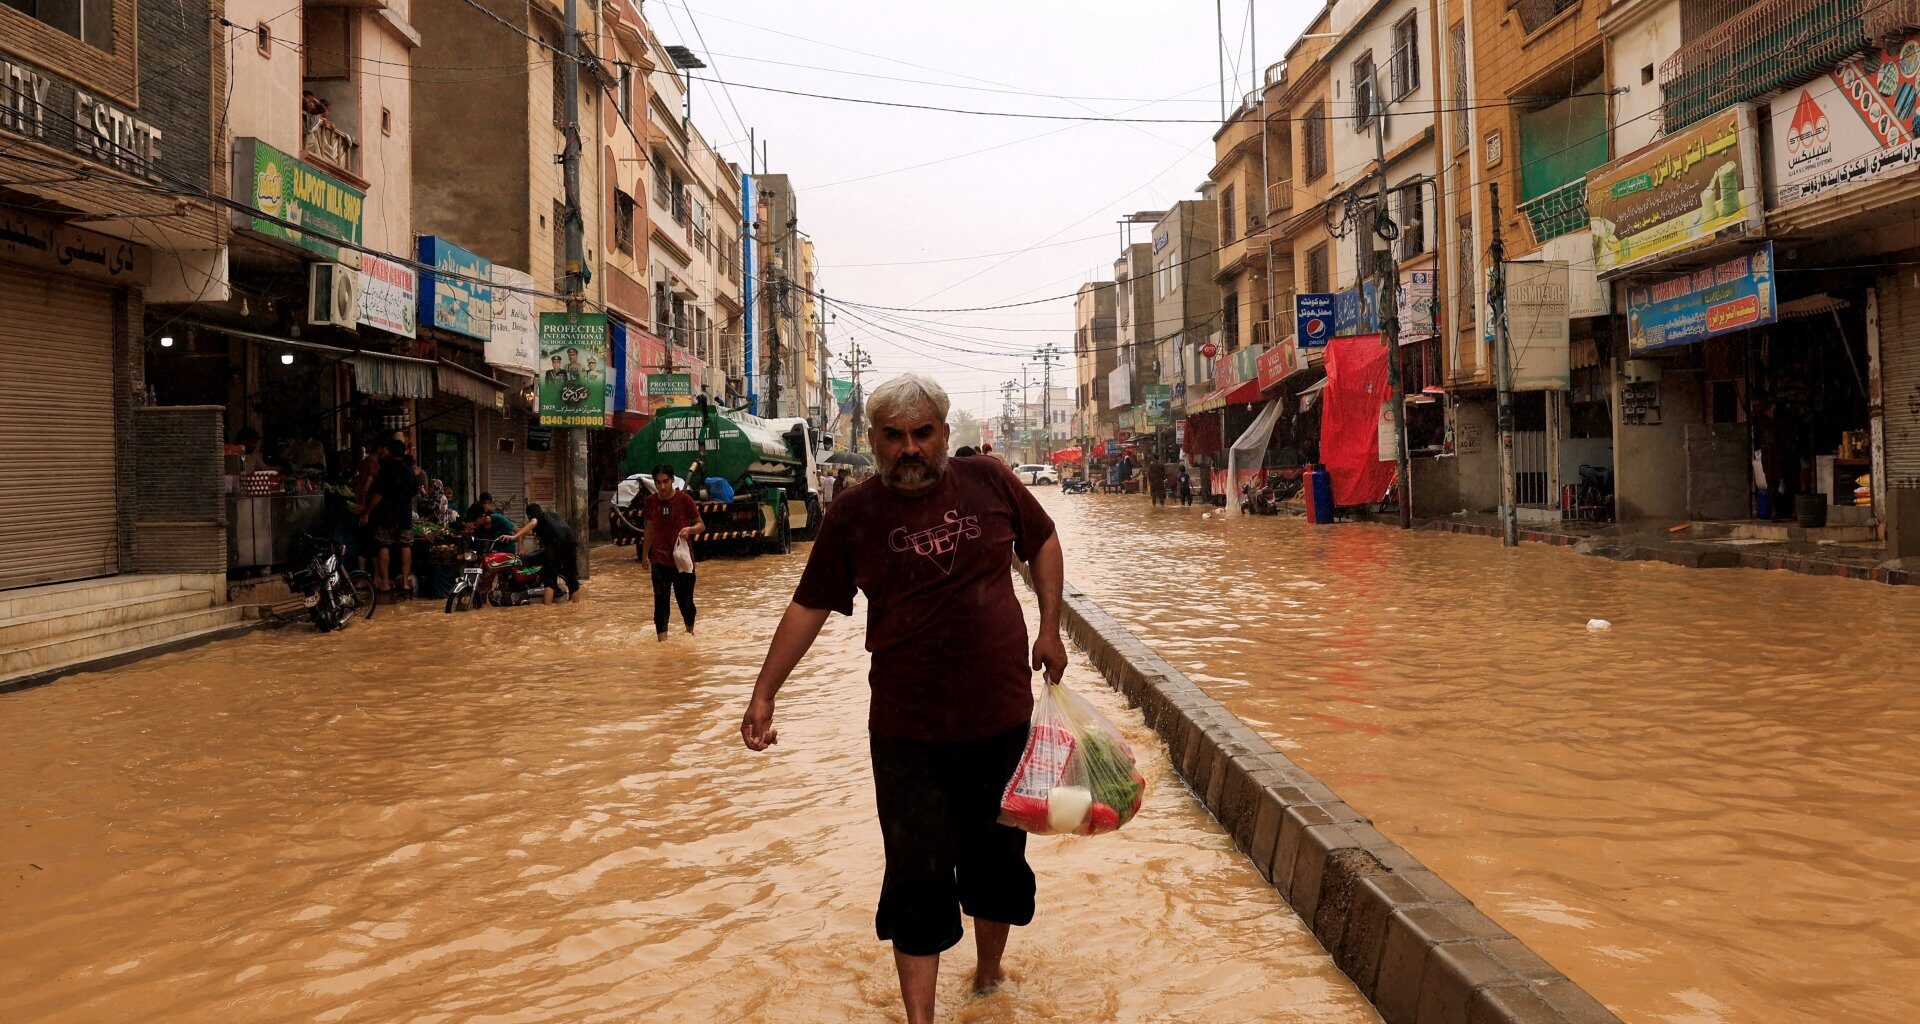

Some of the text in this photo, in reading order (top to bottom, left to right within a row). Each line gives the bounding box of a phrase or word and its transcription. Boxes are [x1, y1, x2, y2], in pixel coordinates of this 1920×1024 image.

[0, 61, 162, 178] ITY ESTATE
[1789, 125, 1828, 145] STEELEX
[343, 192, 361, 225] SHOP
[1509, 284, 1566, 303] BISMILLAH
[543, 324, 604, 333] PROFECTUS
[540, 415, 604, 426] 0340-4190000
[660, 428, 694, 440] CANTONMENTS
[657, 440, 688, 453] CANTONMENT
